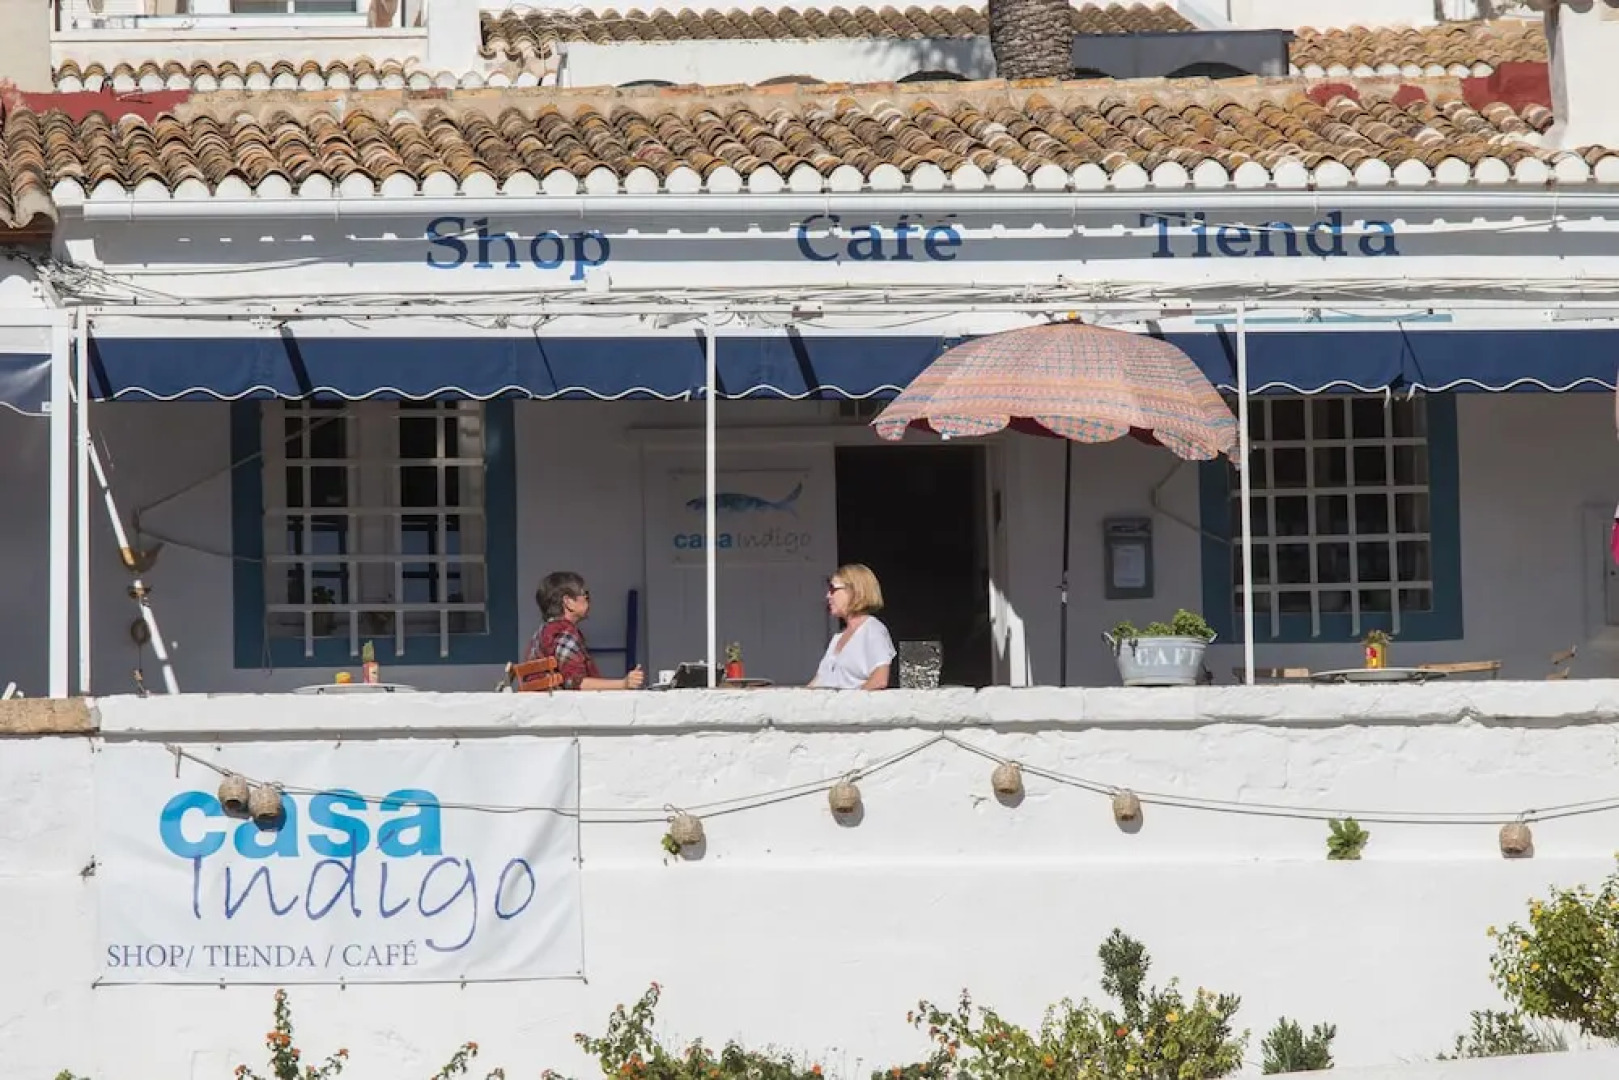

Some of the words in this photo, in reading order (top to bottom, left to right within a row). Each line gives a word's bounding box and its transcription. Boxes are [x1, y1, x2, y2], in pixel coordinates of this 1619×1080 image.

[425, 216, 611, 280] Shop
[797, 213, 963, 262] Café
[1139, 210, 1400, 258] Tienda
[673, 532, 732, 549] caa
[159, 788, 442, 859] casa
[107, 944, 195, 968] SHOP/
[203, 944, 317, 968] TIENDA
[341, 940, 418, 968] CAFÉ
